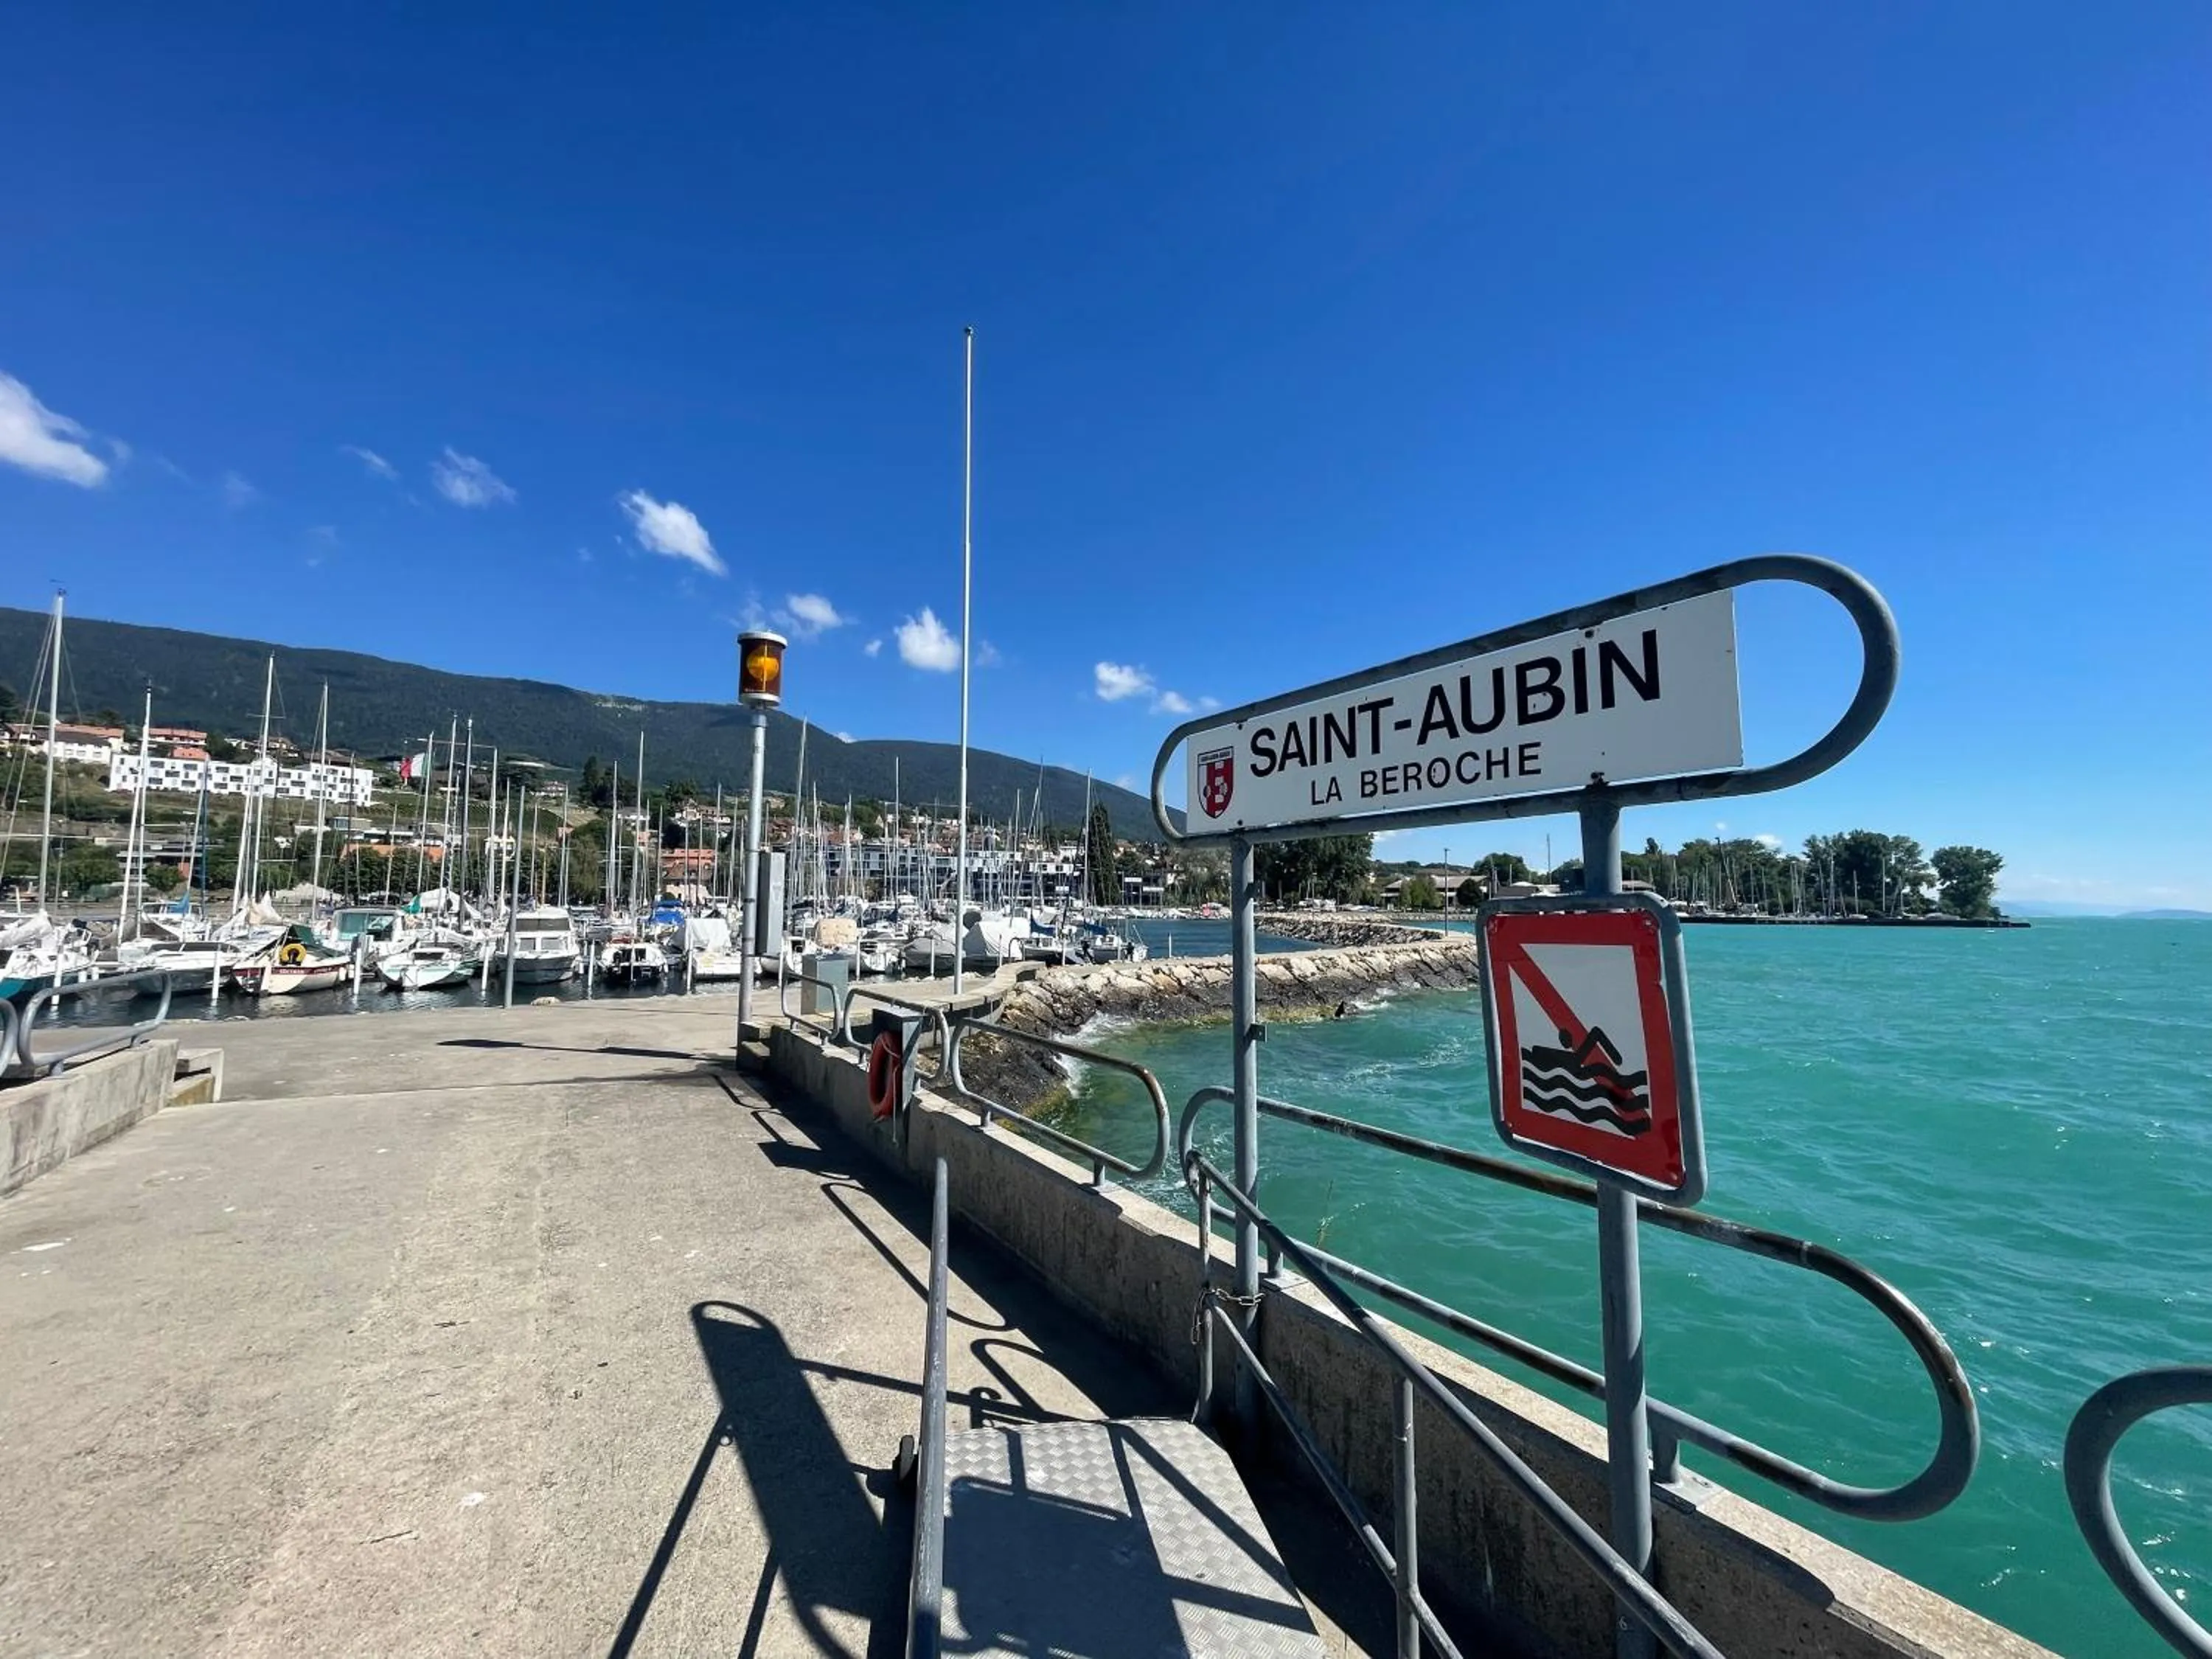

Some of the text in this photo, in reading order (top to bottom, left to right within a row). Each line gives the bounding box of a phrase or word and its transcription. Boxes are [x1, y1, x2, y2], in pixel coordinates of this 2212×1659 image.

[1250, 629, 1661, 778] SAINT-AUBIN
[1310, 742, 1543, 806] LA BEROCHE
